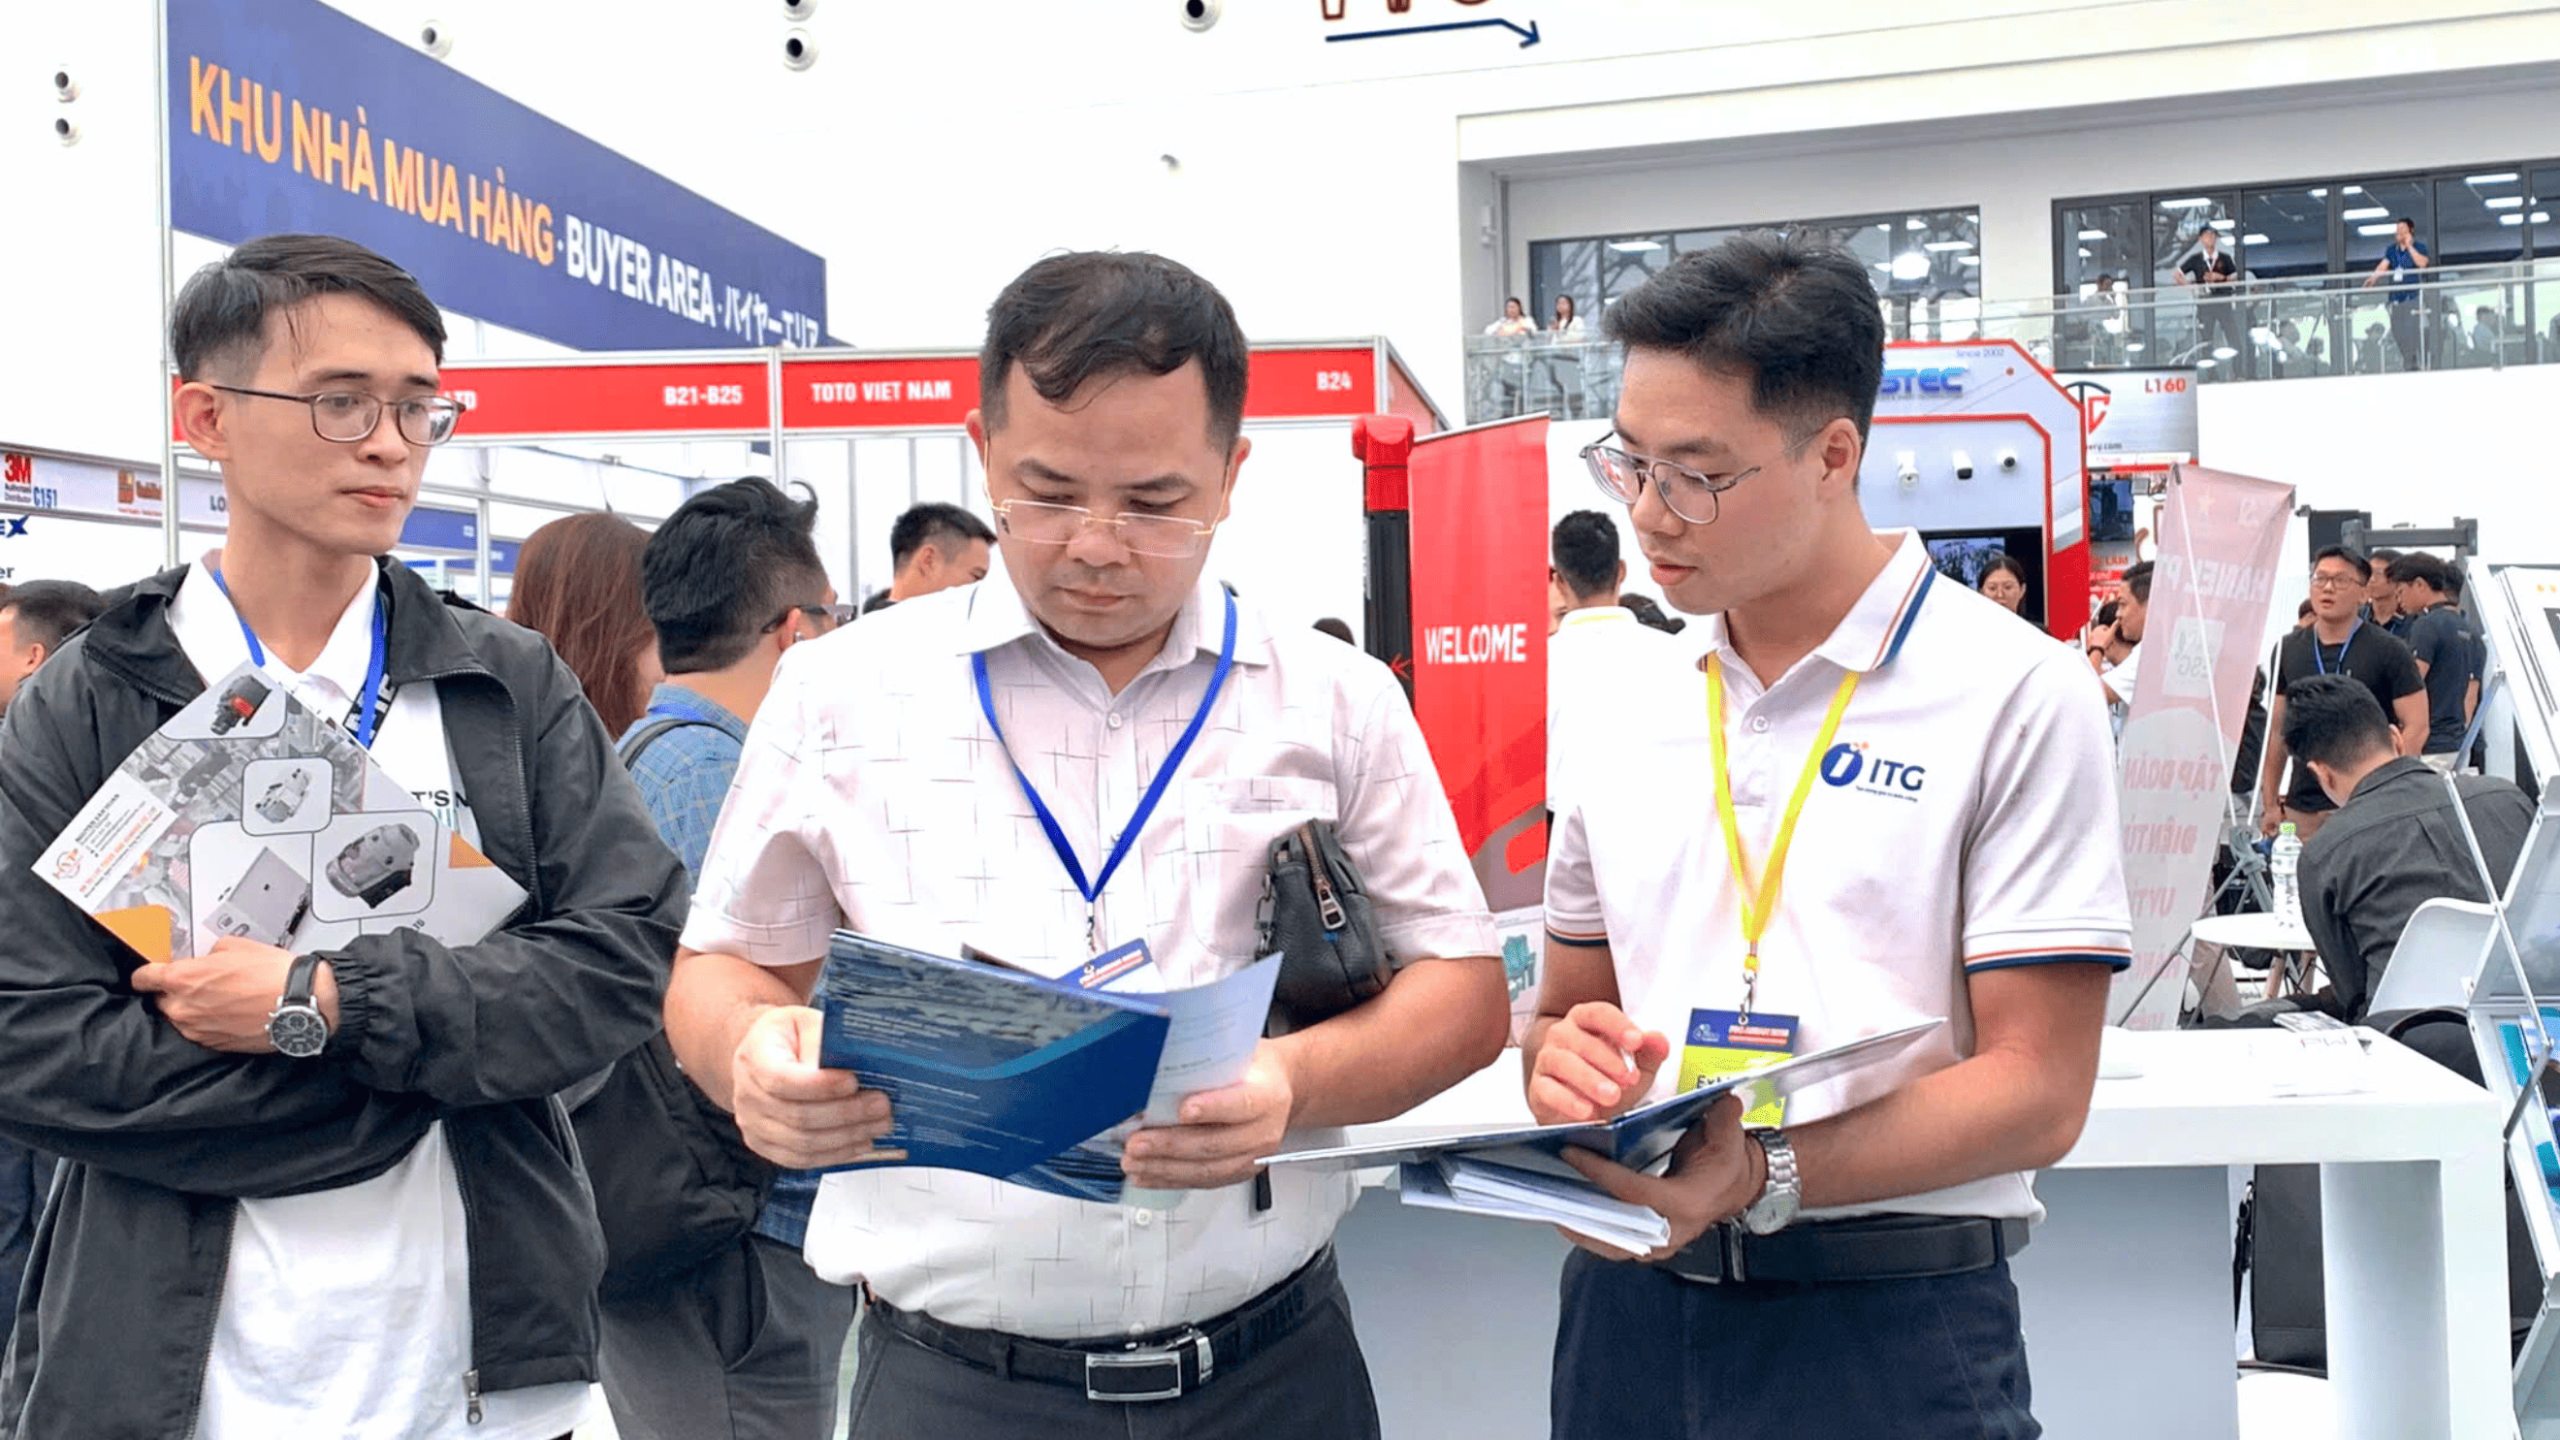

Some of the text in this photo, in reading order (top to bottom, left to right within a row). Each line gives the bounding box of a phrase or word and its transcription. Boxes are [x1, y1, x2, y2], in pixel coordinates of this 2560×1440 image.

[190, 55, 716, 328] KHU NHÀ MUA HÀNG BUYER AREA
[811, 380, 952, 403] TOTO VIET NAM
[1316, 371, 1353, 391] B24
[2144, 377, 2187, 394] L160
[664, 385, 743, 406] B21-B25
[4, 454, 31, 484] 3M
[33, 485, 58, 508] C151
[1424, 622, 1528, 665] WELCOME
[1868, 757, 1926, 792] ITG
